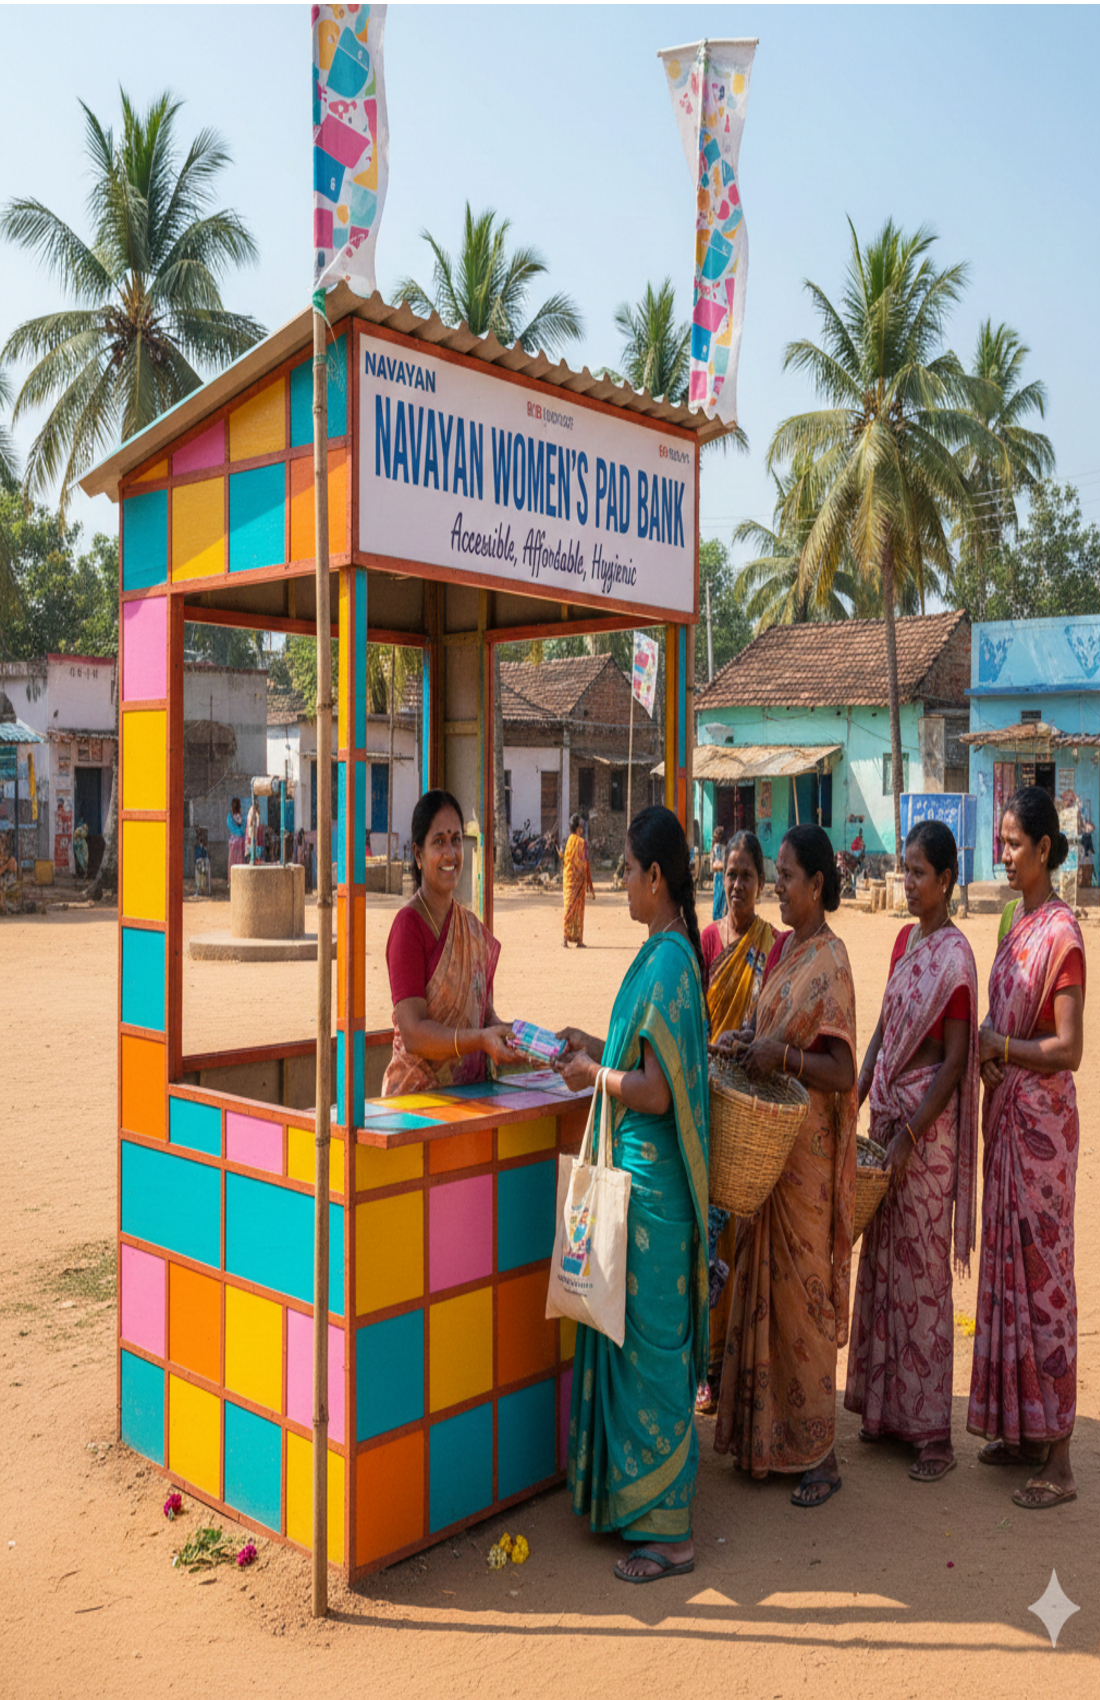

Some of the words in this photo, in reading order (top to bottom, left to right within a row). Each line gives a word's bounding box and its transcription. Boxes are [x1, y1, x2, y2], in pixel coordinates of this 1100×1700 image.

[364, 350, 436, 393] NAVAYAN
[375, 394, 484, 501] NAVAYAN
[491, 426, 589, 526] WOMEN'S
[595, 456, 631, 535] PAD
[637, 469, 685, 549] BANK
[451, 511, 518, 568] Accessible,
[522, 527, 587, 582] Affordable,
[591, 543, 637, 594] Hygienic
